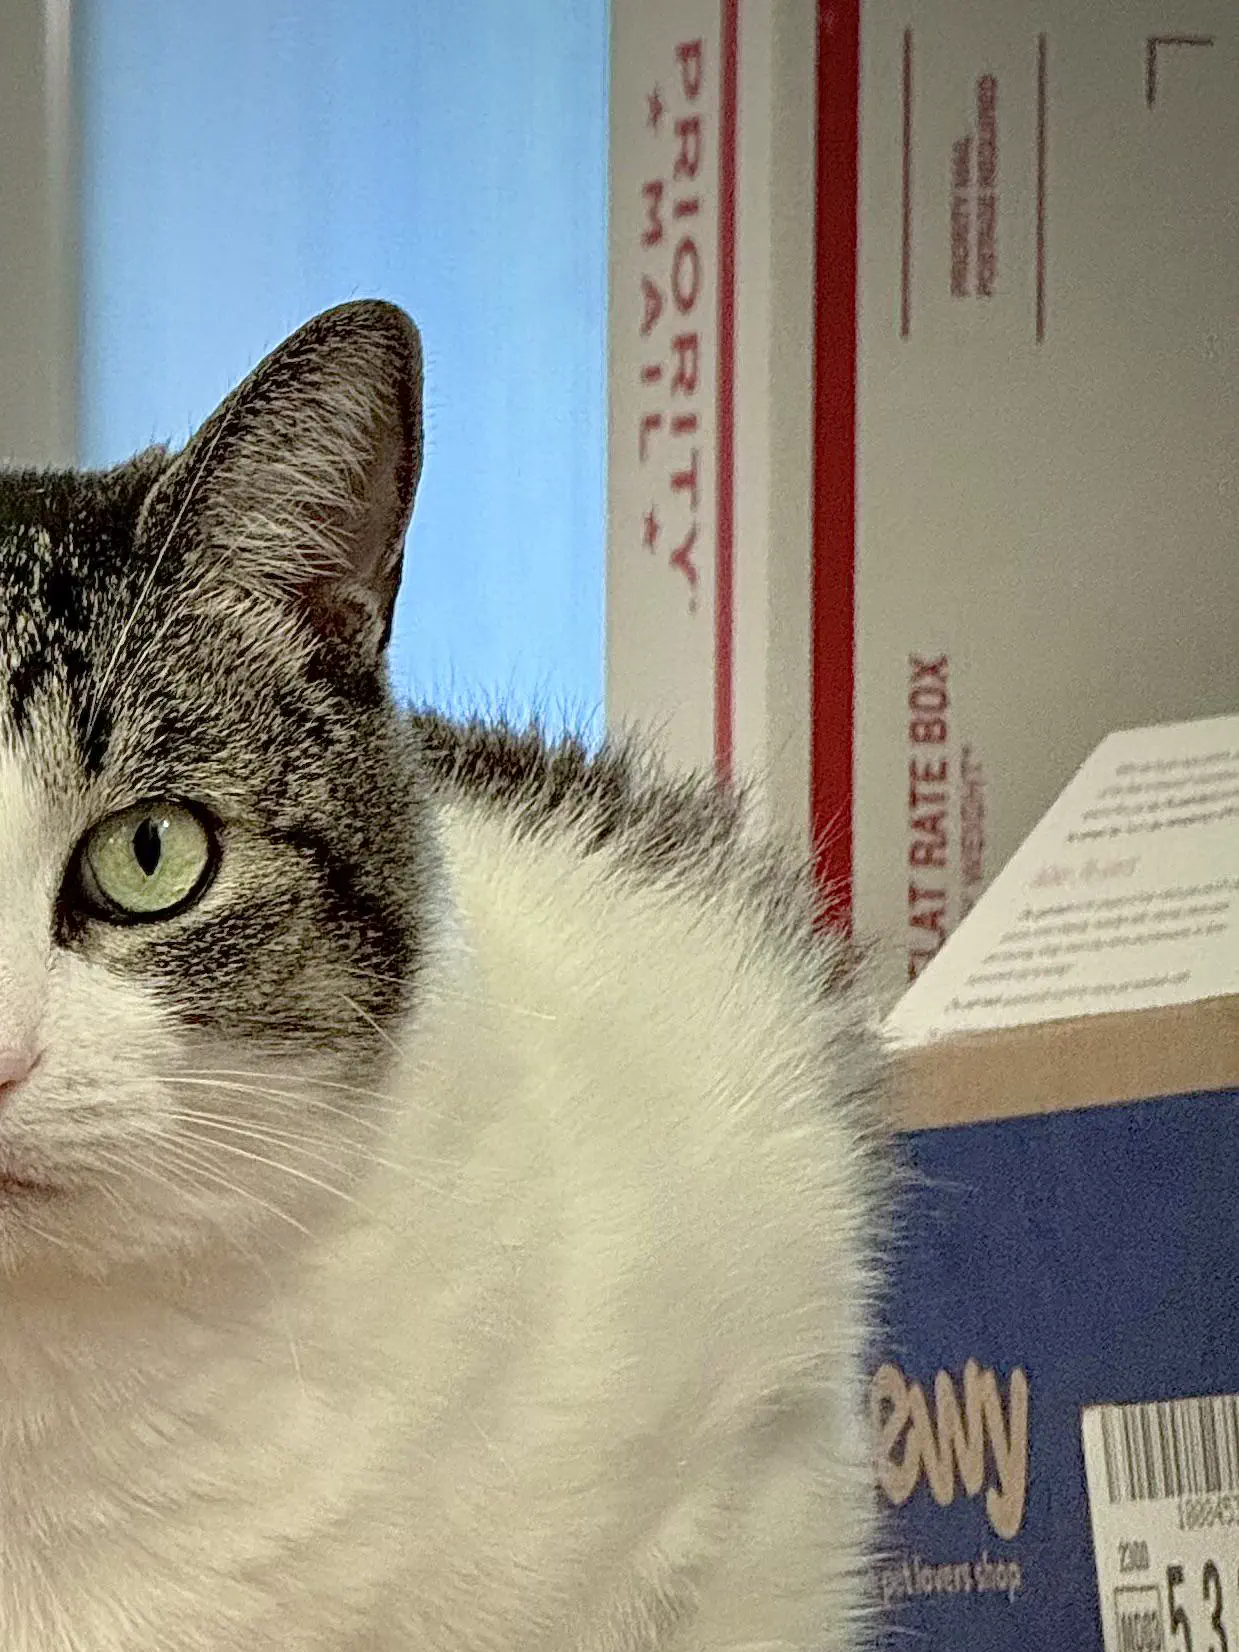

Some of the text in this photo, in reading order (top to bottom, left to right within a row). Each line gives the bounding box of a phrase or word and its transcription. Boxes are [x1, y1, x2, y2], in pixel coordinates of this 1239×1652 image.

[639, 179, 664, 463] MAIL
[668, 38, 703, 590] PRIORITY
[909, 652, 948, 745] BOX
[909, 760, 947, 868] RATE
[870, 1357, 1029, 1540] ewy
[975, 1550, 1023, 1603] shop
